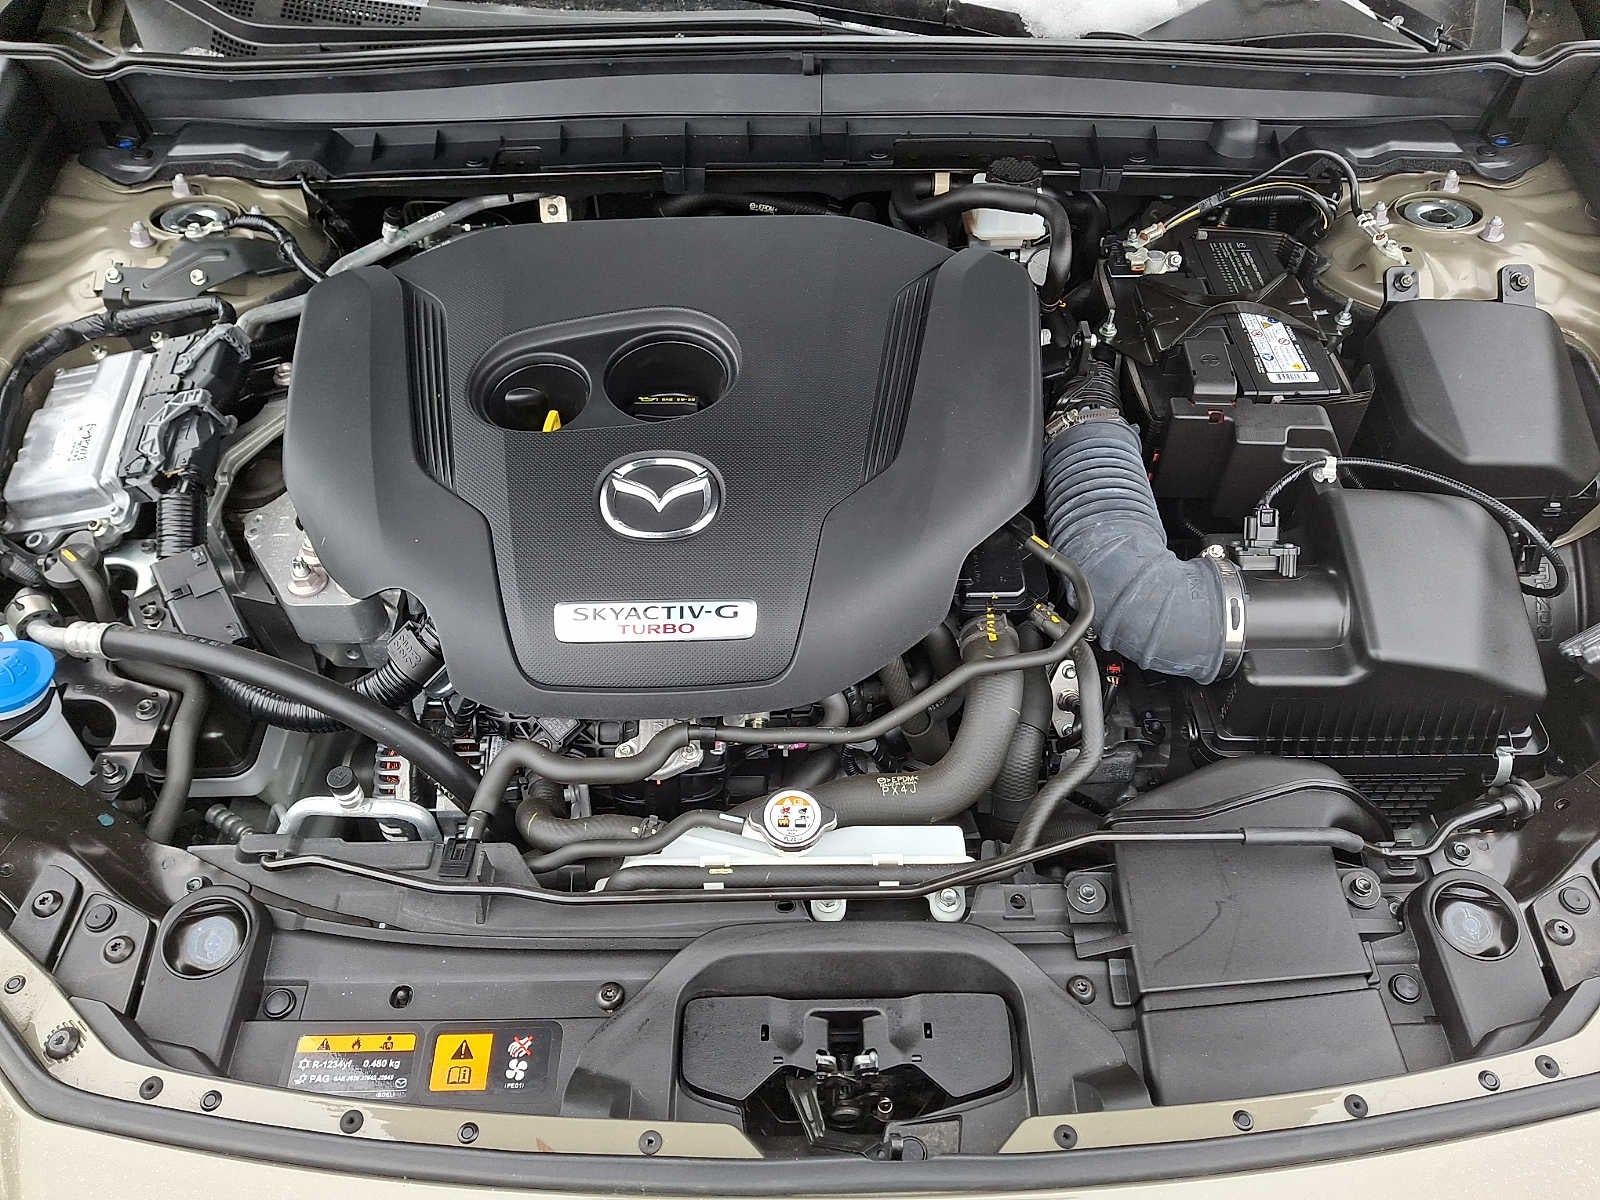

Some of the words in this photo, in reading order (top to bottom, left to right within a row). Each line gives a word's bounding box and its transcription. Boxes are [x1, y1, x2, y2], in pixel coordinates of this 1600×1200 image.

[572, 604, 739, 622] SKYACTIV-G
[618, 623, 695, 635] TURBO
[389, 1059, 400, 1070] kg
[309, 1074, 330, 1083] PAG
